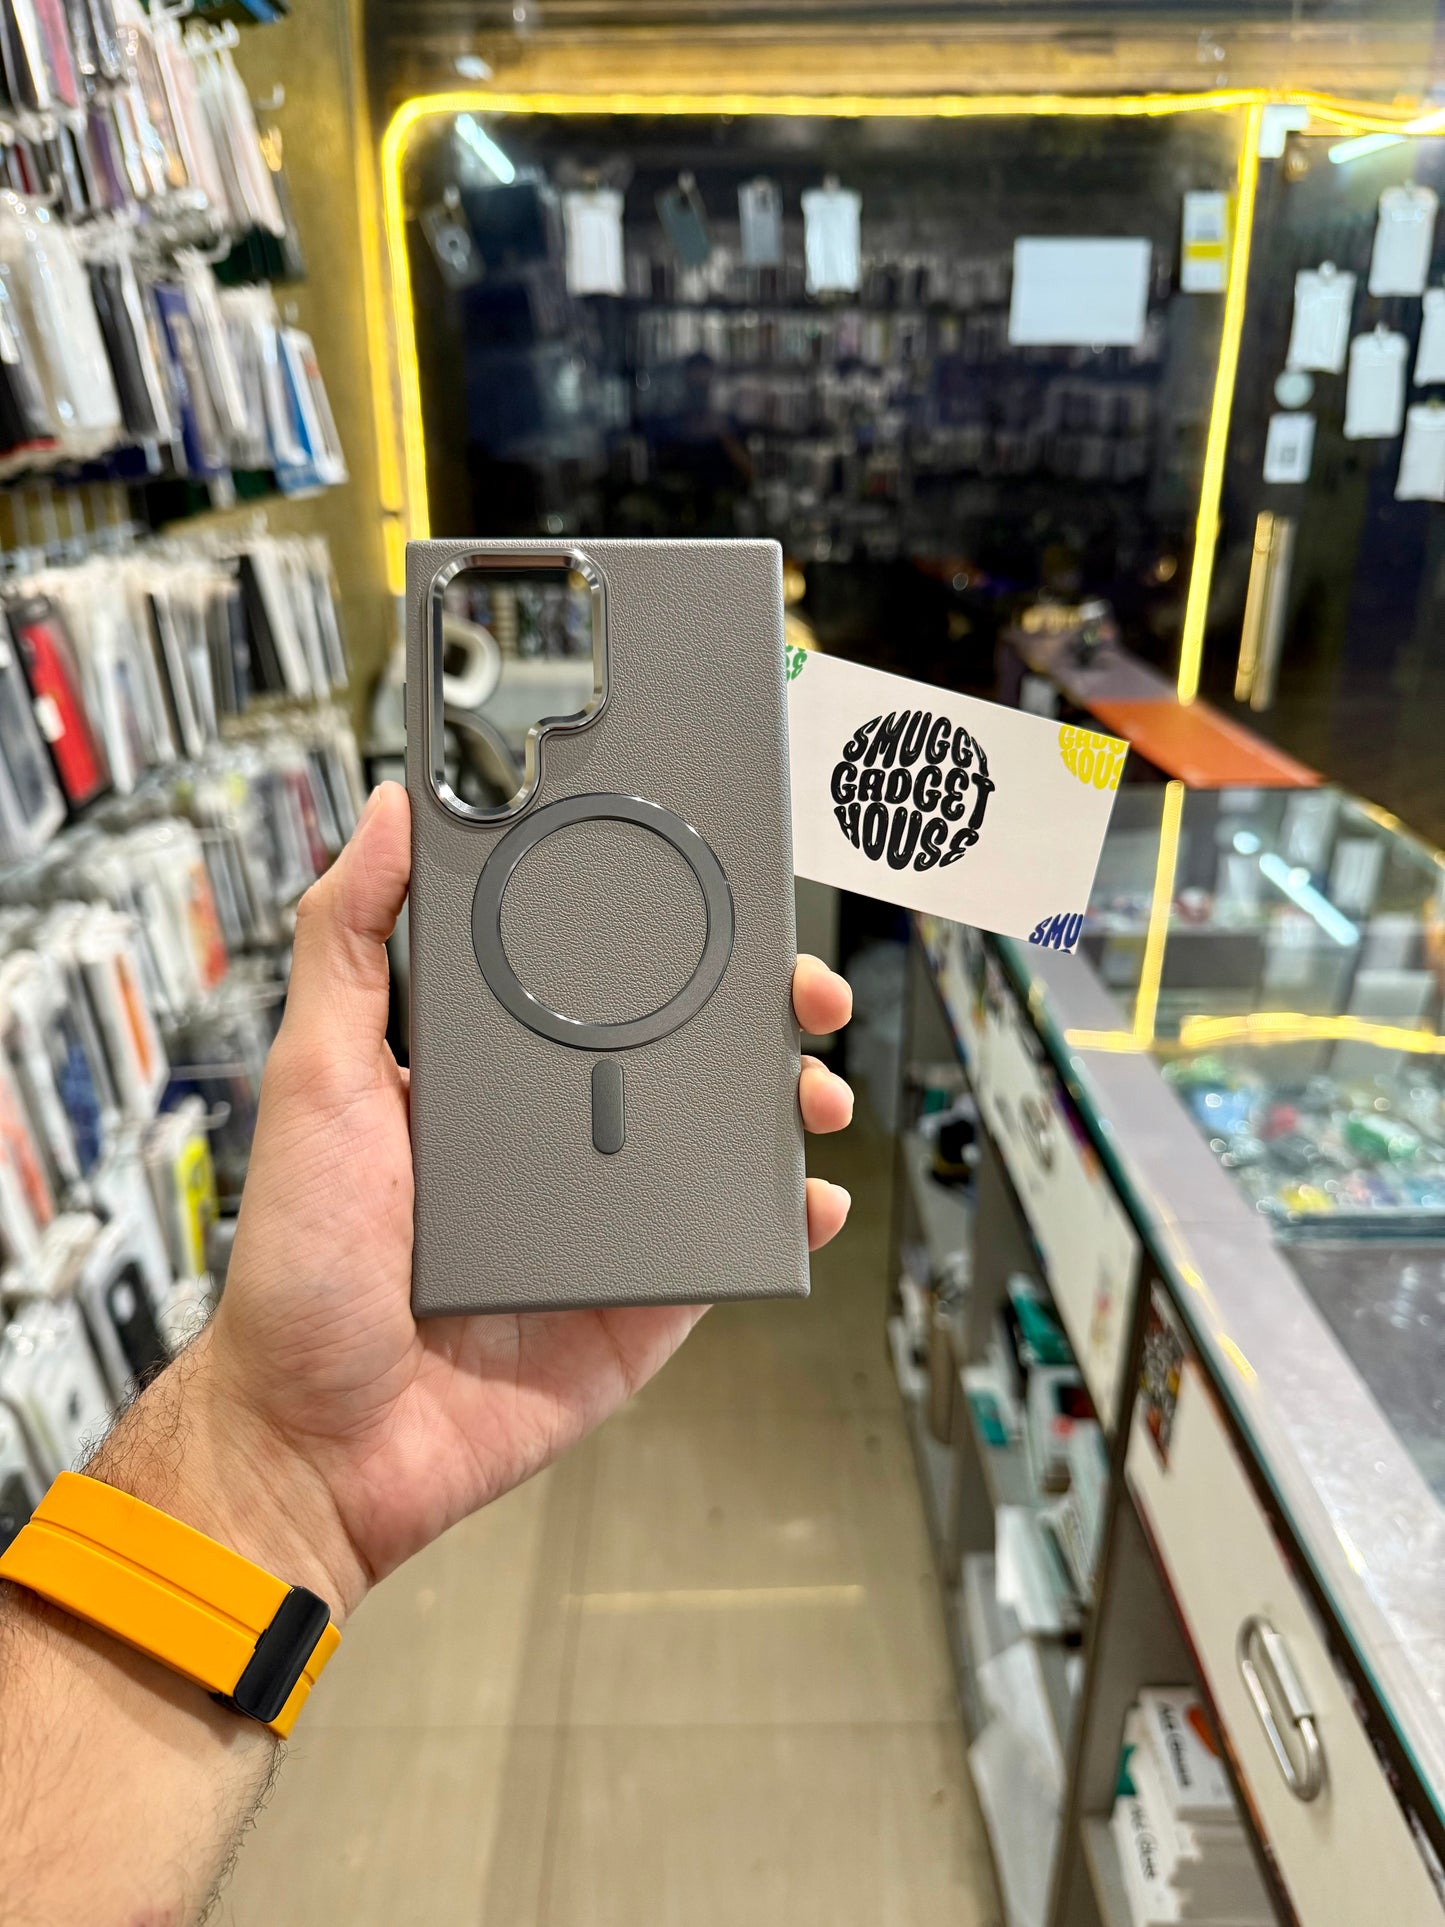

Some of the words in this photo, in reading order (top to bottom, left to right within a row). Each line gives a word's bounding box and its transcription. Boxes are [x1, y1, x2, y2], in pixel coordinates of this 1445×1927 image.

[831, 761, 995, 830] GADGET
[834, 802, 979, 872] HOUSE
[1029, 912, 1084, 950] SMU
